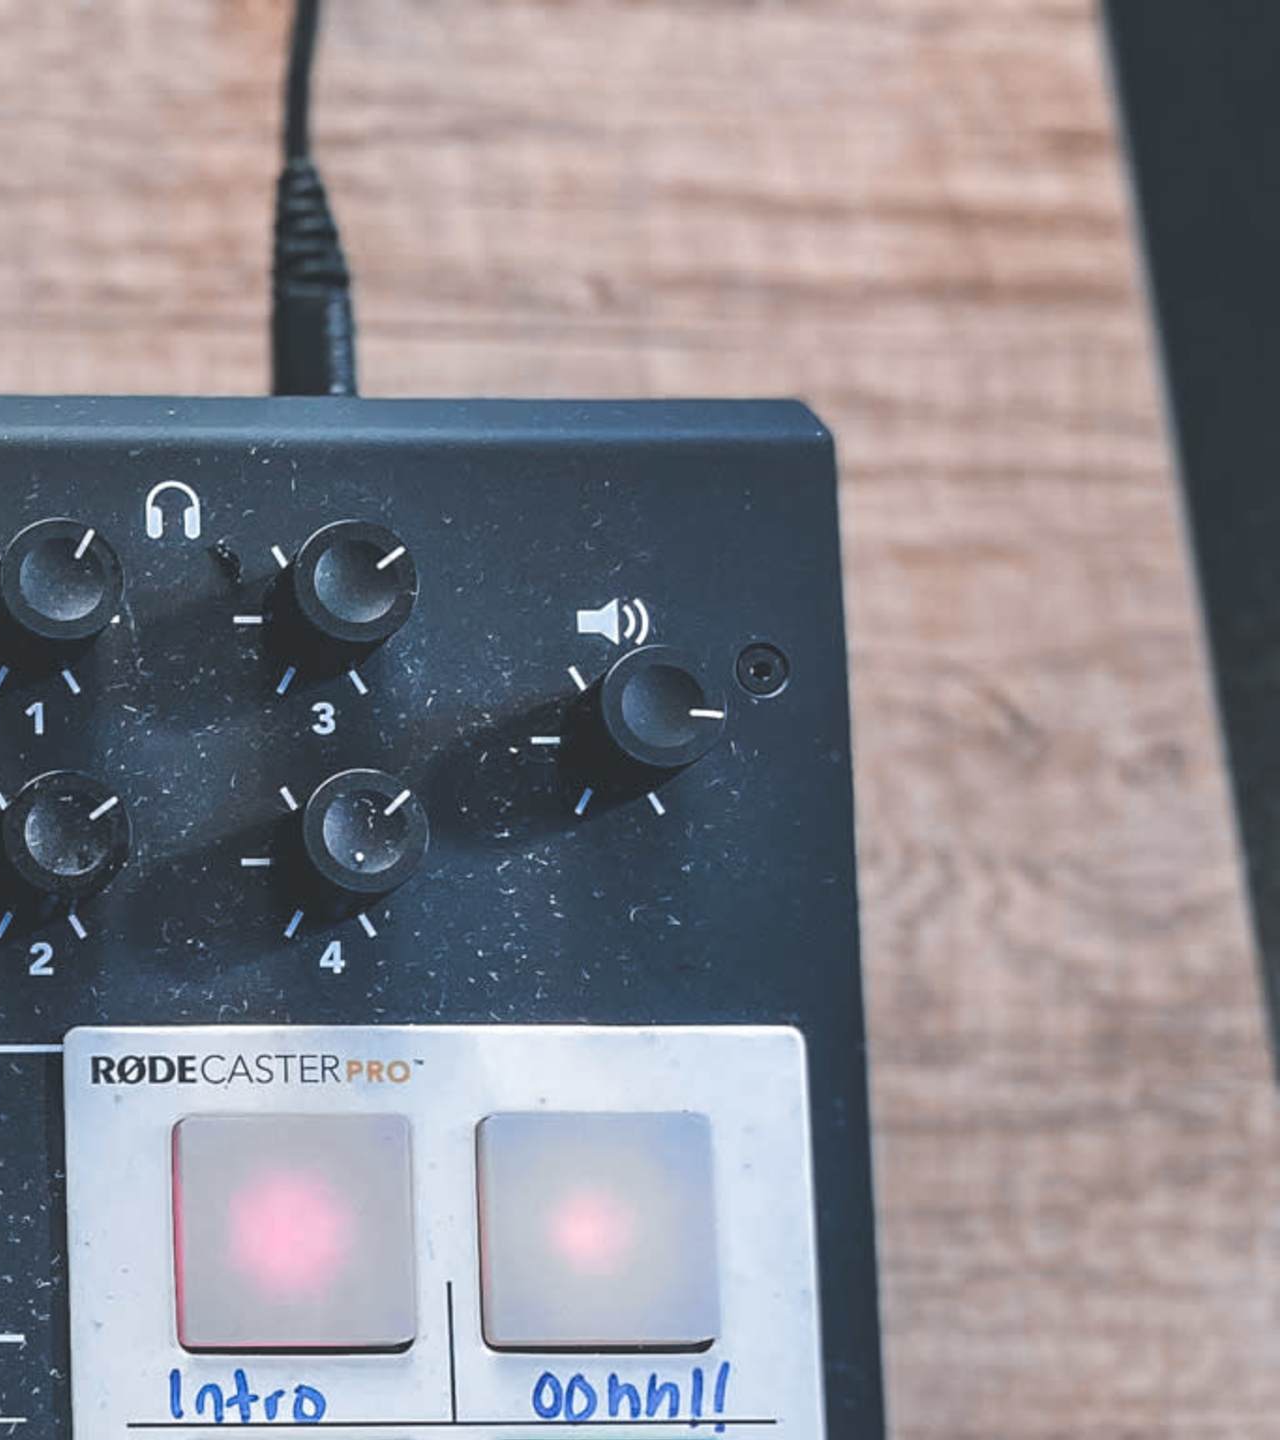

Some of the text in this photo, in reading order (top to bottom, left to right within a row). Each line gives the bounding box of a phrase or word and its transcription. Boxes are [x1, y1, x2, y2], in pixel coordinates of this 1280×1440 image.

[25, 702, 44, 735] 1
[311, 702, 337, 735] 3
[29, 942, 55, 976] 2
[318, 940, 346, 974] 4
[169, 1368, 327, 1423] Intro
